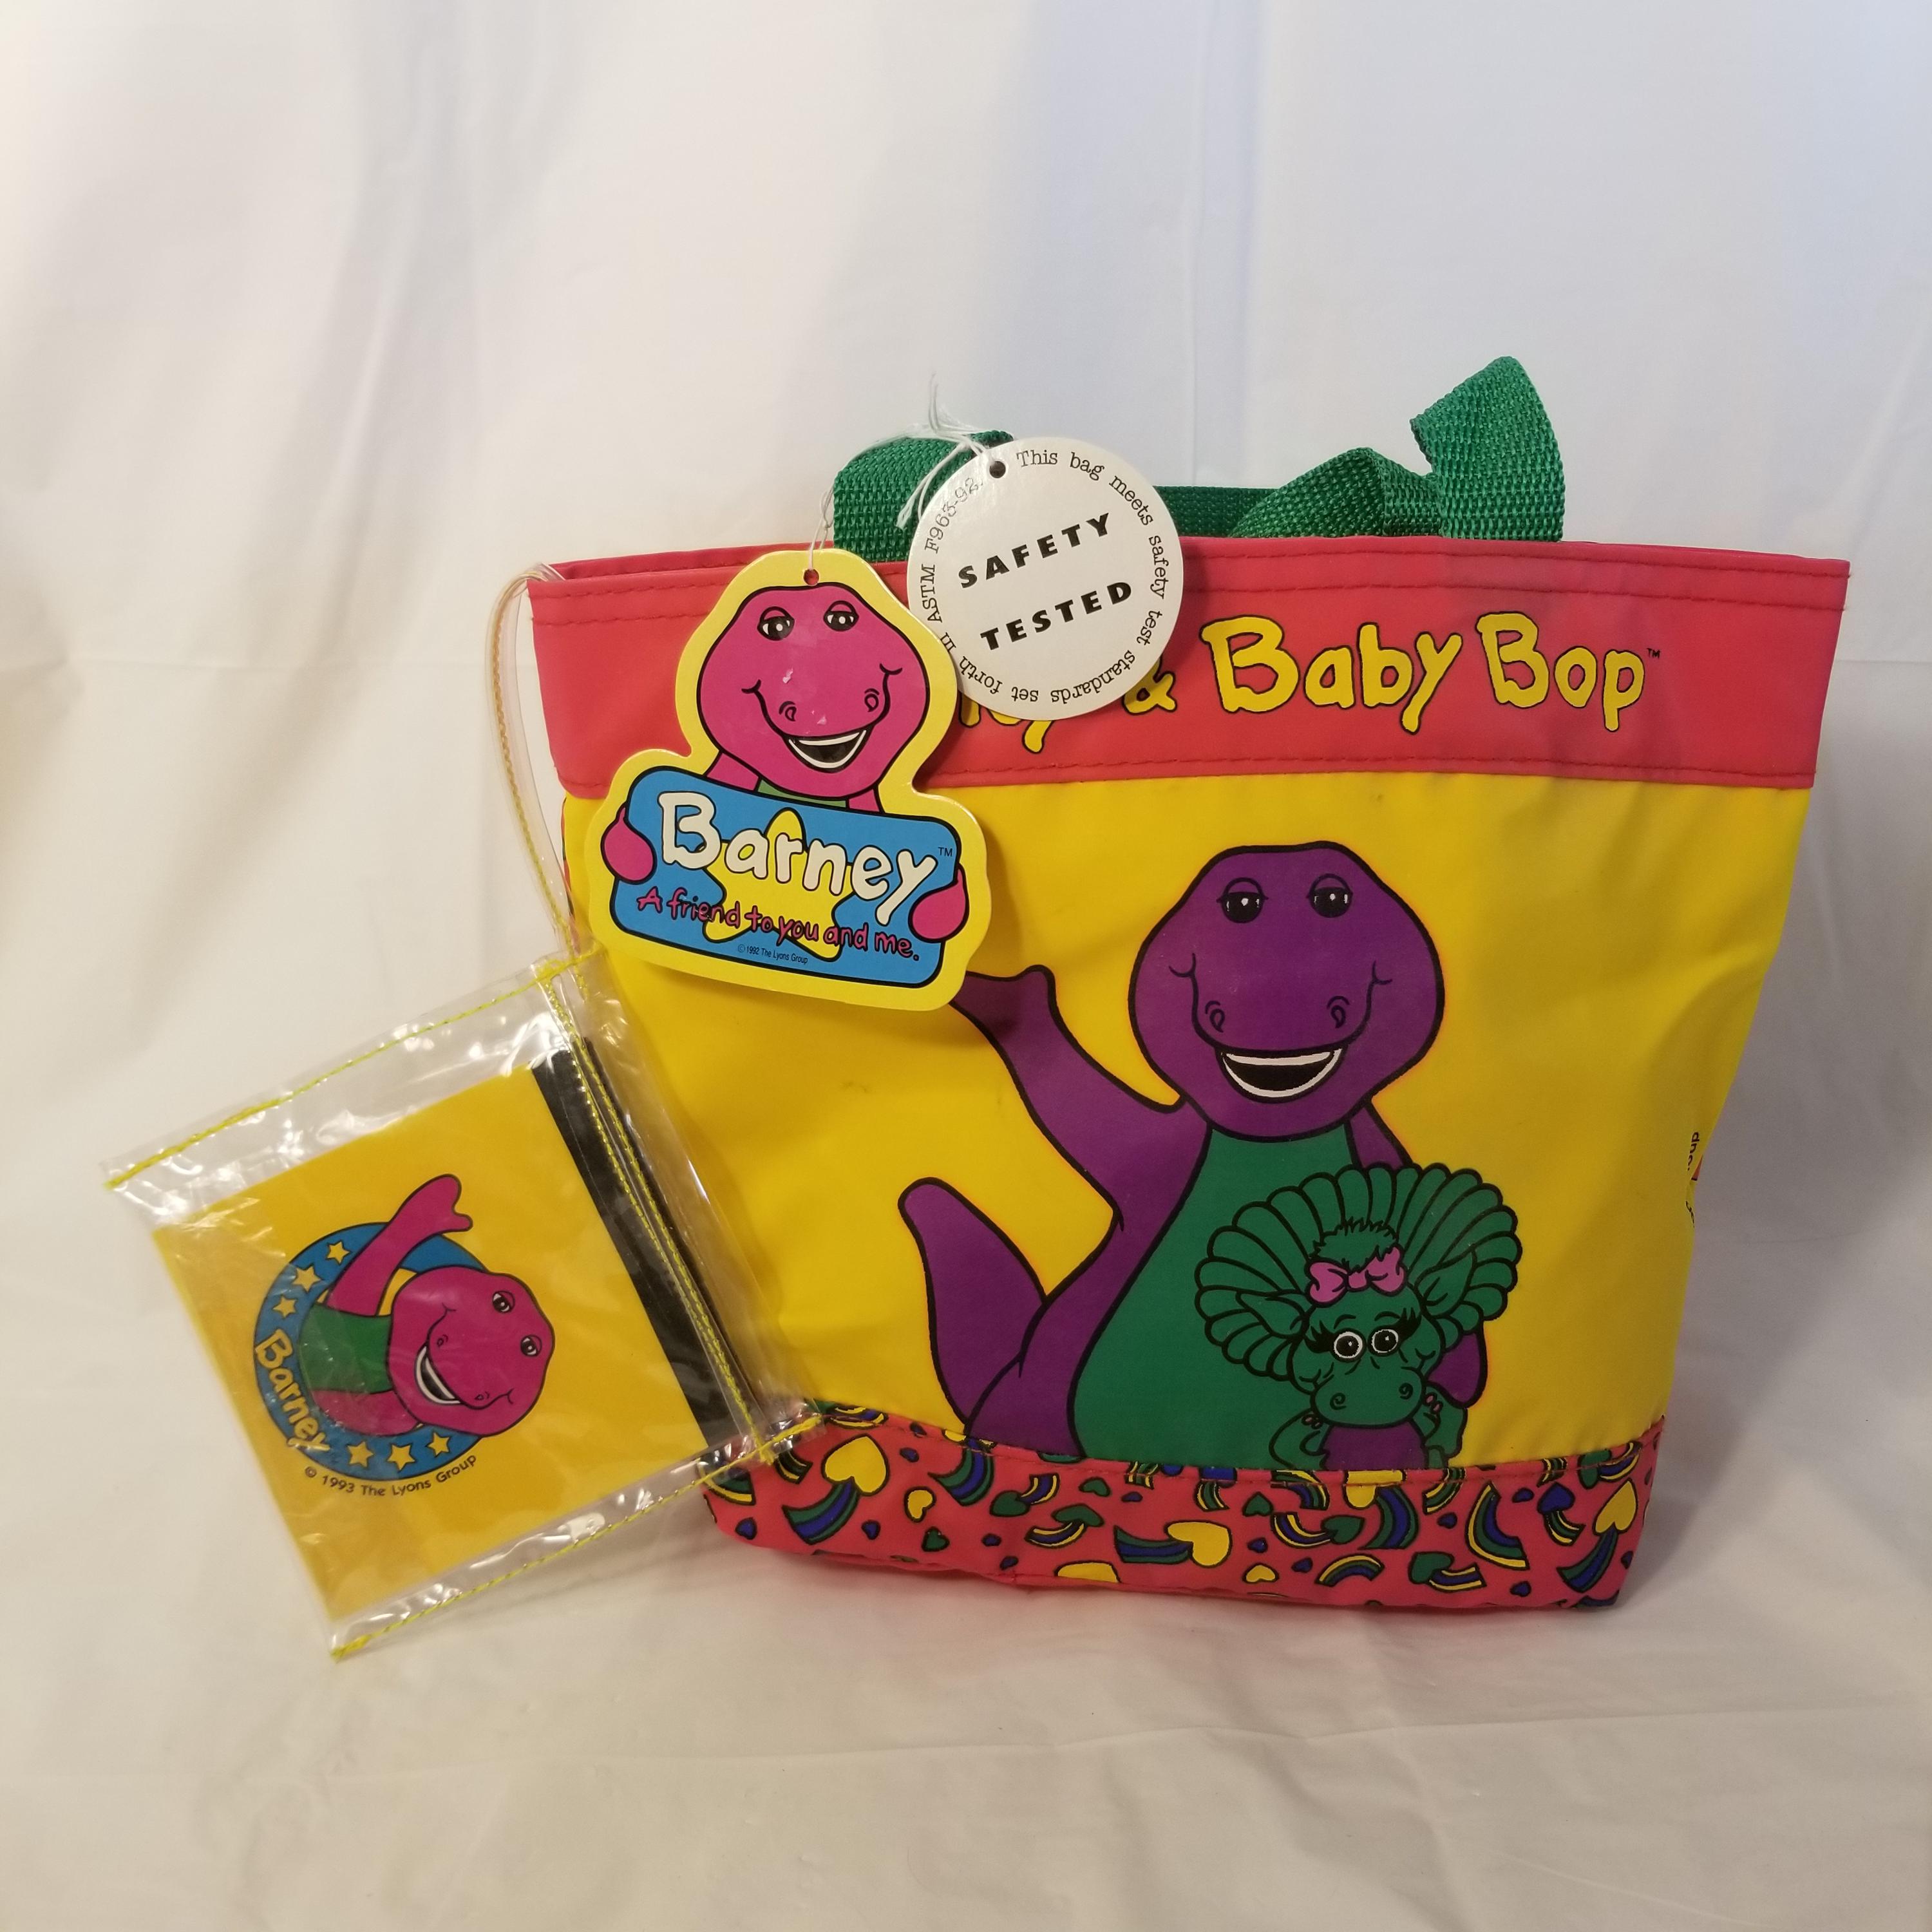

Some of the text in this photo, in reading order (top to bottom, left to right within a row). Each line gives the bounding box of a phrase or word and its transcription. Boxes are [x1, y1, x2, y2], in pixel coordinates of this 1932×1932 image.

[1016, 449, 1058, 468] This
[1070, 451, 1105, 482] bag
[1109, 475, 1154, 526] meets
[958, 512, 1110, 589] SAFETY
[1149, 535, 1169, 600] safety
[920, 564, 943, 623] ASTM
[980, 582, 1132, 650] TESTED
[1137, 610, 1163, 647] test
[959, 656, 1003, 696] forth
[1011, 686, 1039, 702] set
[1050, 650, 1136, 704] standards
[1200, 614, 1463, 734] Baby
[1475, 611, 1645, 733] Bop
[657, 790, 938, 926] Barney
[636, 886, 920, 961] A friend to you and me.
[746, 945, 760, 955] 1992
[761, 947, 772, 958] The
[773, 950, 790, 961] Lyons
[791, 953, 808, 965] Group
[254, 1329, 330, 1452] Barney
[321, 1475, 355, 1493] 1993
[361, 1484, 386, 1496] The
[392, 1480, 431, 1496] Lyons
[435, 1455, 477, 1483] Group
